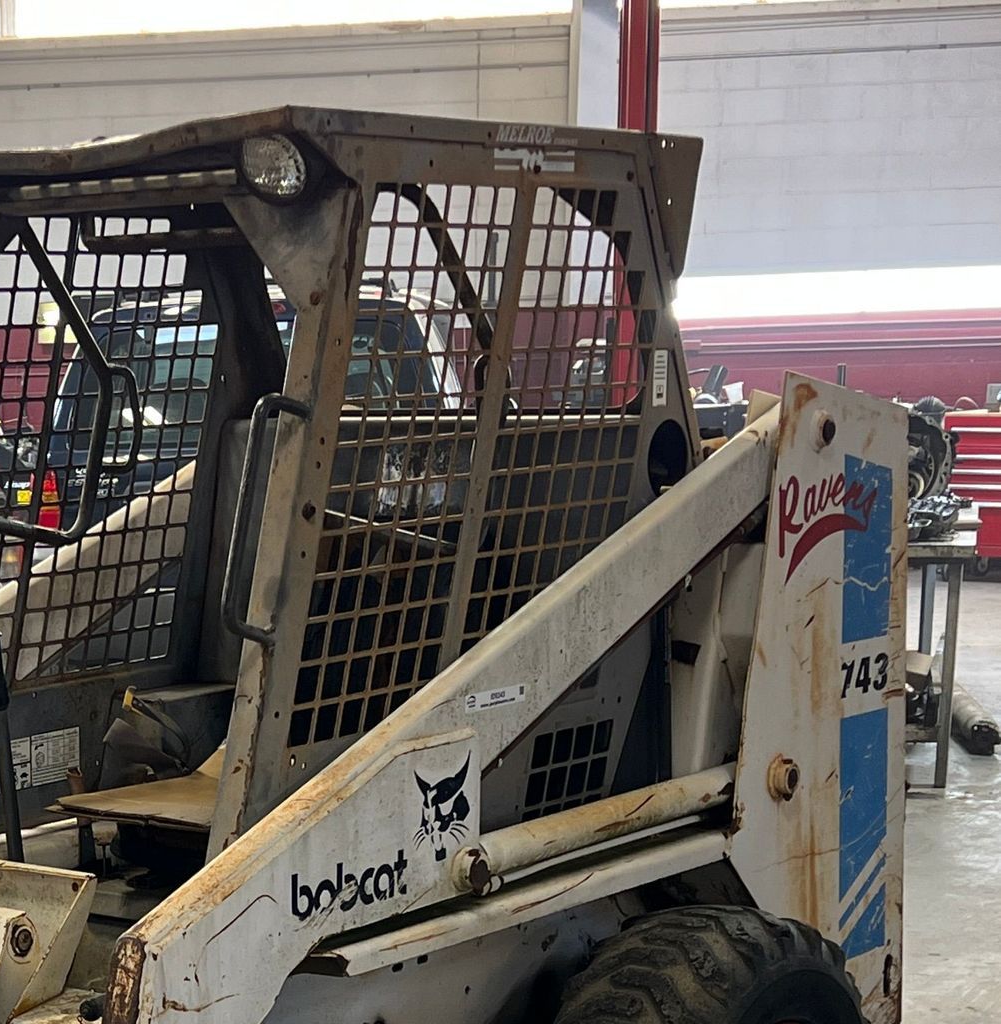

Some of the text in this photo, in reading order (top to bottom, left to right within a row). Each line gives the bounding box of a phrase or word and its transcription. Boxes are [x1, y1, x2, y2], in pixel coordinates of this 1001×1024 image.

[496, 125, 555, 145] MELROE
[779, 473, 878, 558] Ravens
[841, 652, 888, 699] 743
[291, 849, 408, 921] bobcat
